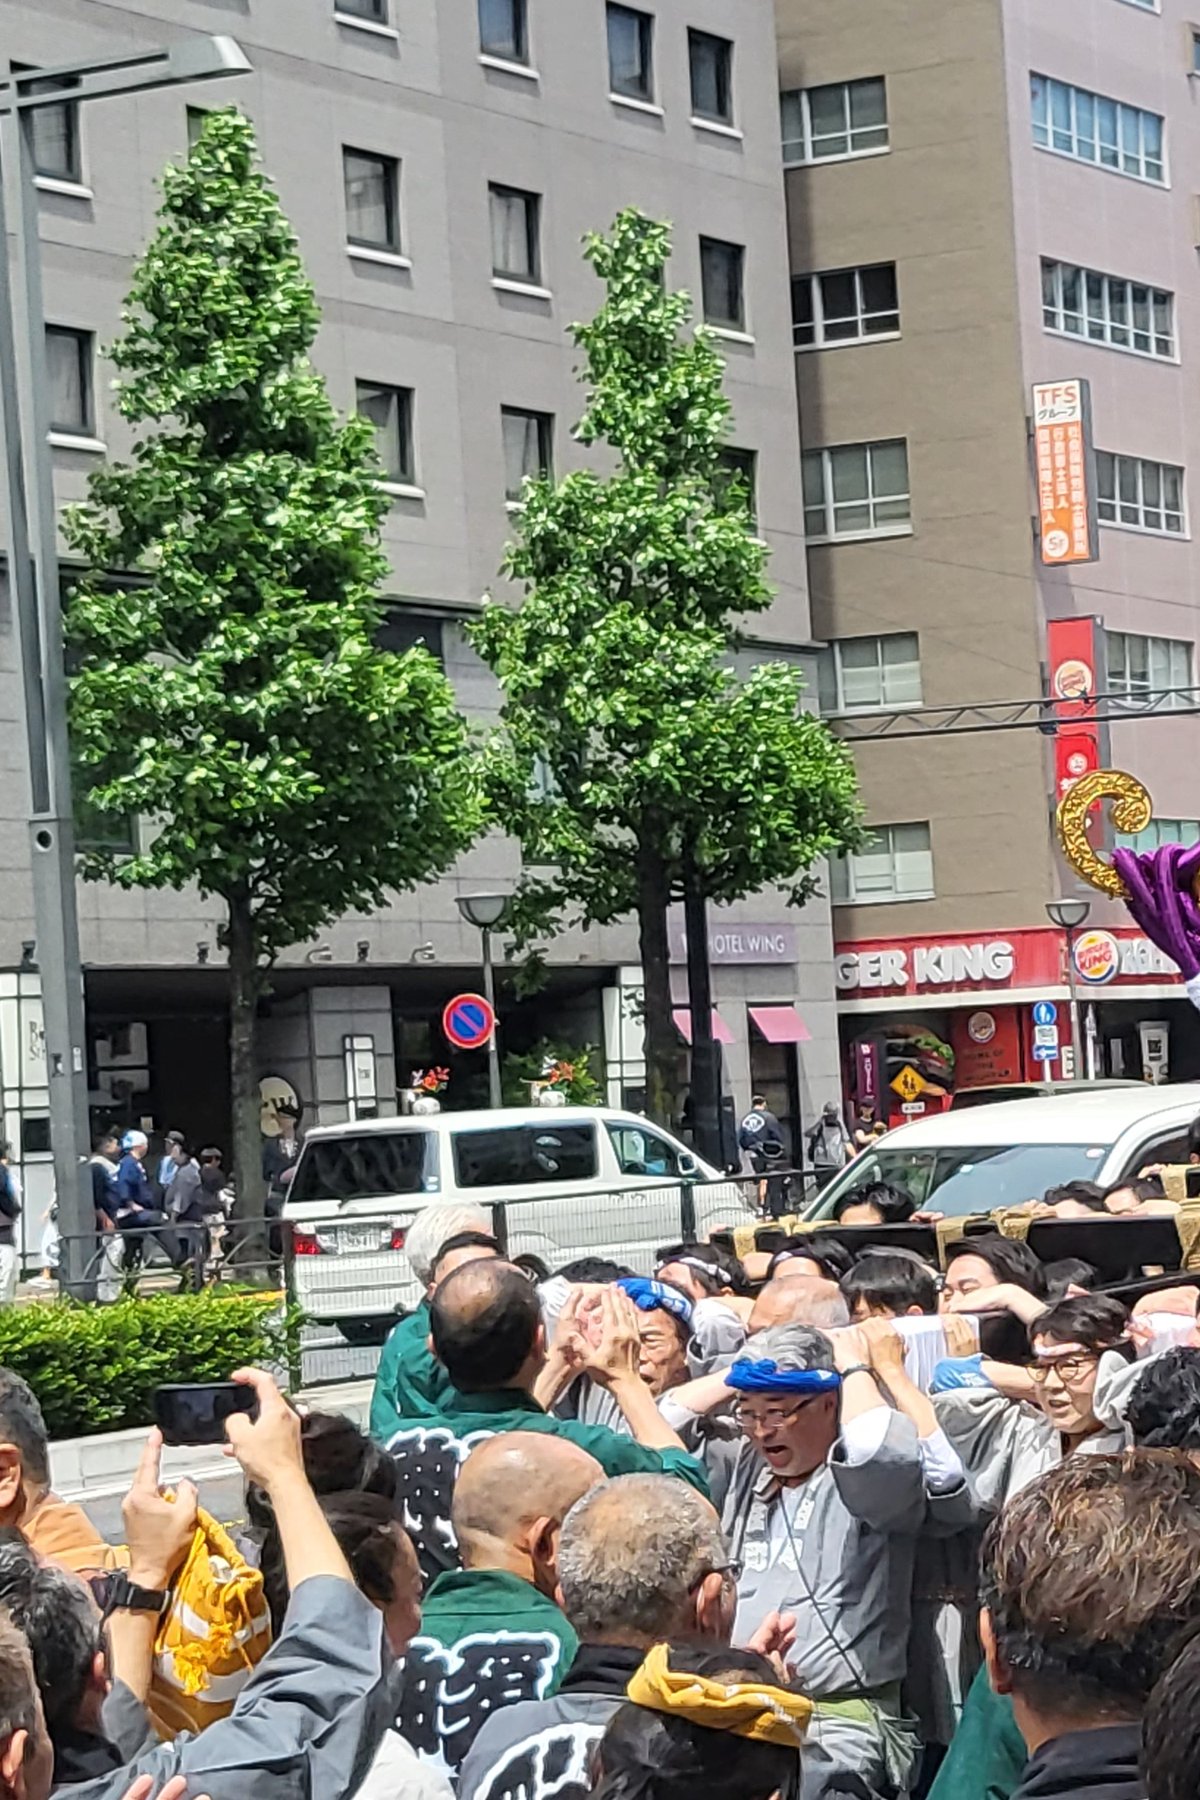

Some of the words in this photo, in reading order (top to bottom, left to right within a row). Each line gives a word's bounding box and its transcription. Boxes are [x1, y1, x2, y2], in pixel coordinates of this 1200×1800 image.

[1037, 386, 1077, 406] TFS
[1038, 405, 1077, 420] グループ
[747, 934, 785, 953] WING
[915, 941, 1014, 984] KING
[1079, 950, 1112, 970] KING
